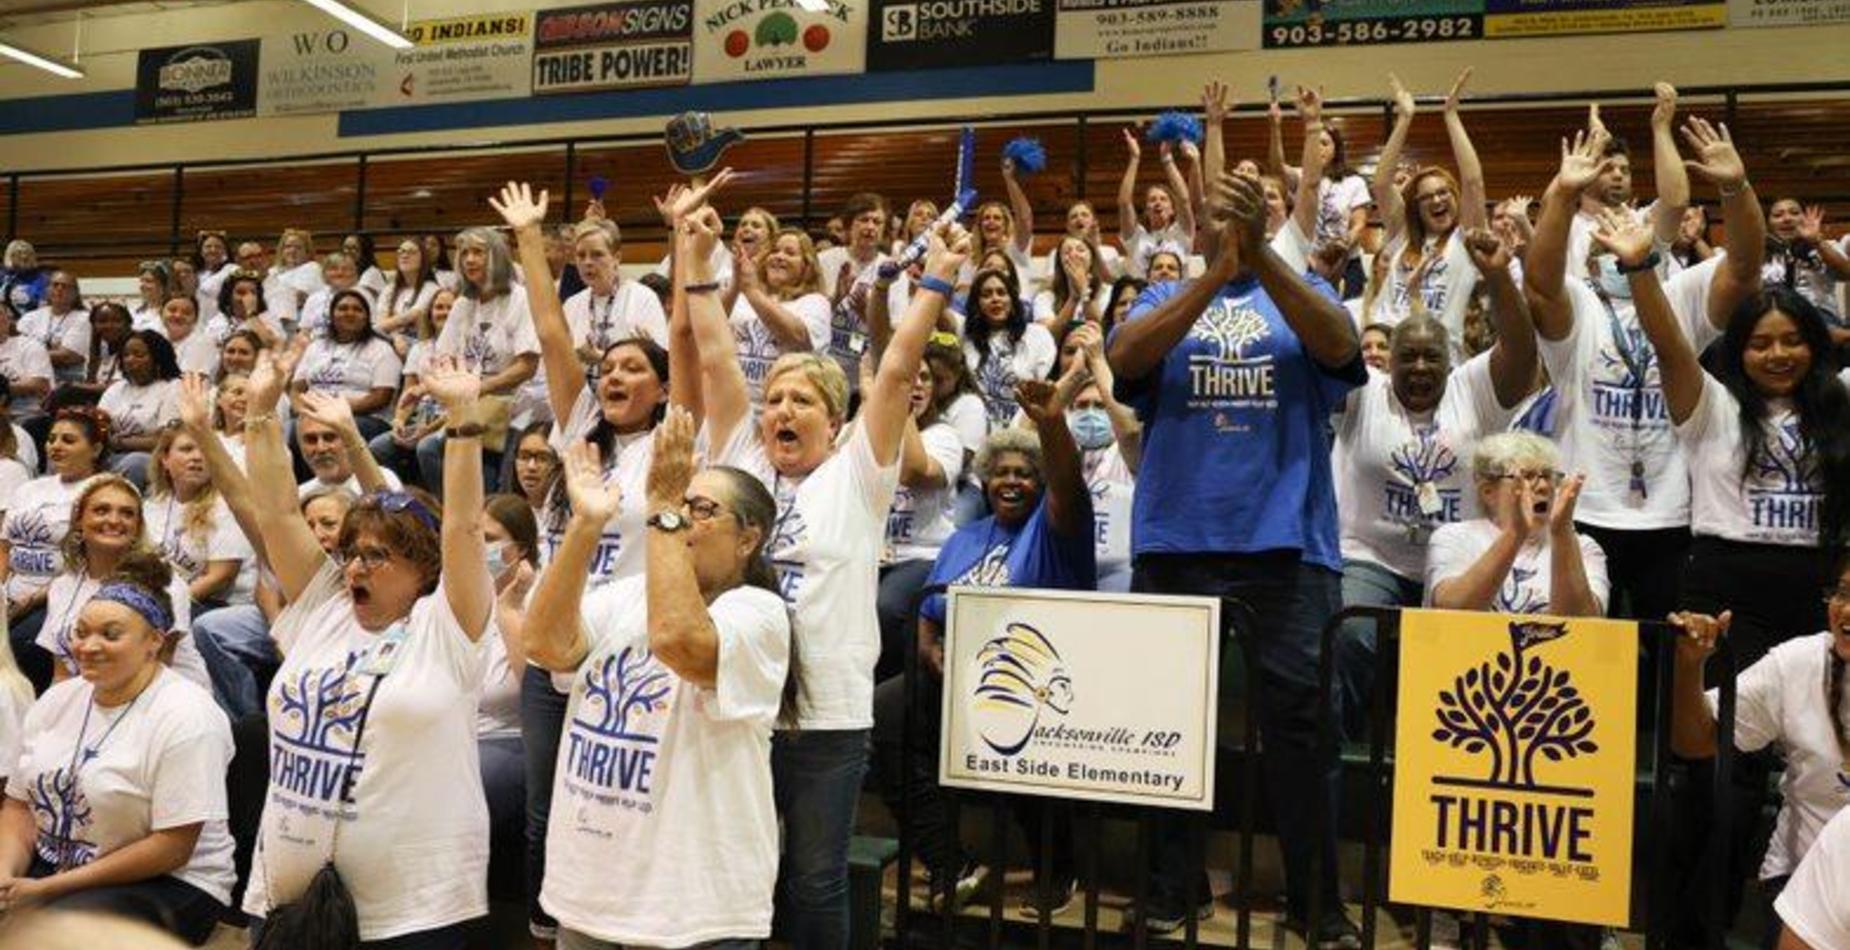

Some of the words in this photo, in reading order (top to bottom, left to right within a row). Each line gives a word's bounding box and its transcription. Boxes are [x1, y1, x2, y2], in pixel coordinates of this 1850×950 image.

[705, 0, 753, 31] NICK
[918, 0, 1041, 20] SOUTHSIDE
[1096, 6, 1220, 25] 903-589-8888
[430, 18, 525, 41] INDIANS!
[919, 19, 977, 39] BANK
[1273, 18, 1473, 44] 903-586-2982
[293, 32, 318, 56] W
[326, 30, 348, 54] O
[1106, 40, 1129, 54] Go
[537, 52, 594, 85] TRIBE
[601, 46, 689, 79] POWER!
[744, 56, 806, 71] LAWYER
[1189, 364, 1276, 396] THRIVE
[1141, 730, 1182, 749] ISD
[272, 743, 363, 803] THRIVE
[567, 732, 656, 793] THRIVE
[966, 754, 1009, 773] East
[1015, 759, 1060, 778] Side
[1067, 762, 1185, 792] Elementary
[1430, 795, 1595, 862] THRIVE
